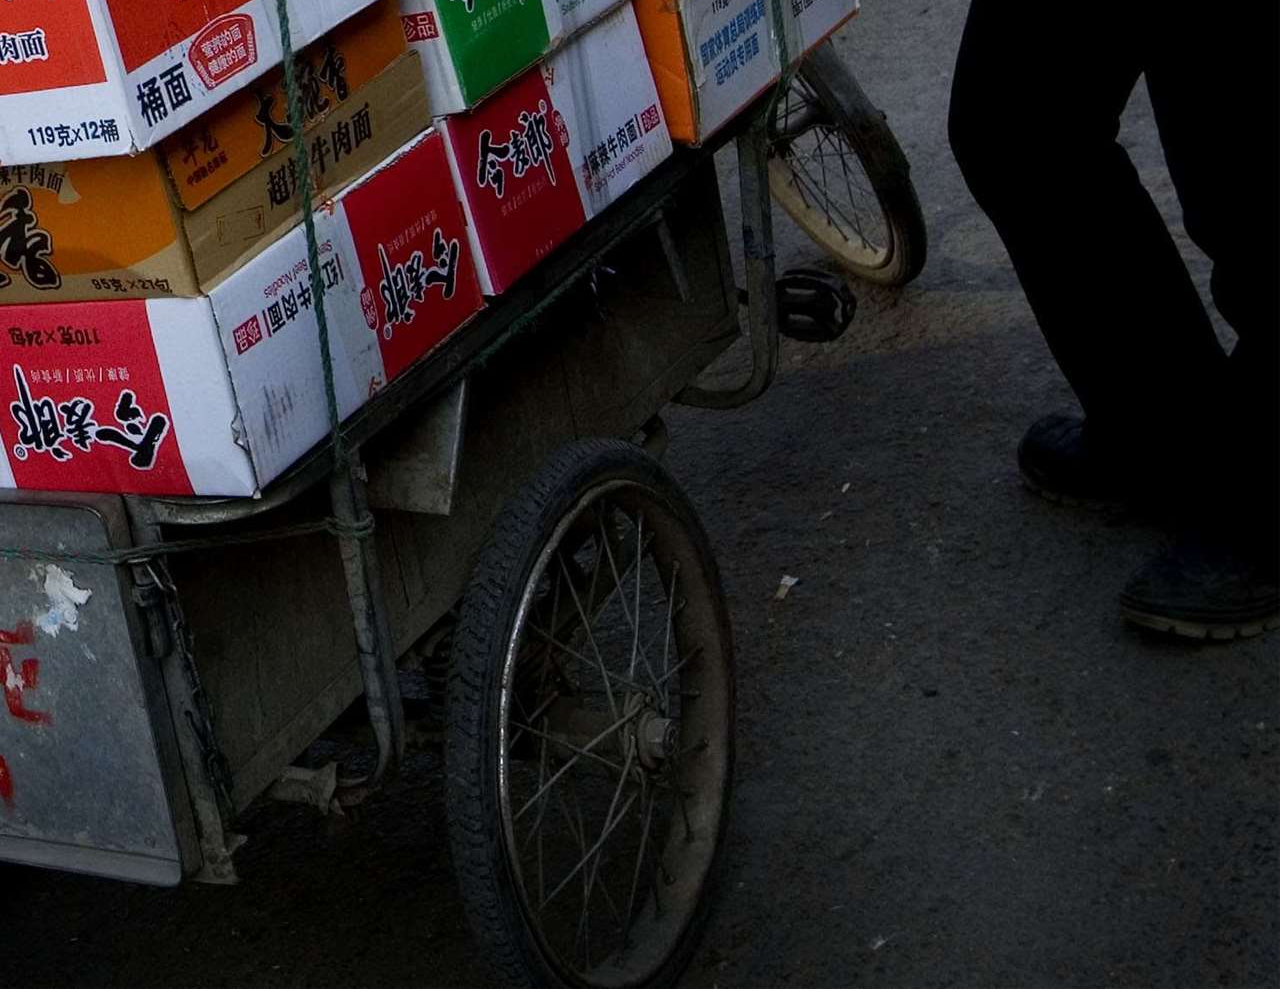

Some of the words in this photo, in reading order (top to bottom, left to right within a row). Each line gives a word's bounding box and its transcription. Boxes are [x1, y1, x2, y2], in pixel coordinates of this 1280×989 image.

[28, 119, 119, 147] 119克x12桶
[135, 63, 192, 126] 桶面
[477, 111, 557, 199] 今麦郎
[267, 255, 341, 334] 红牛肉面
[376, 228, 460, 328] 今麦郎
[12, 364, 170, 470] 今麦郎
